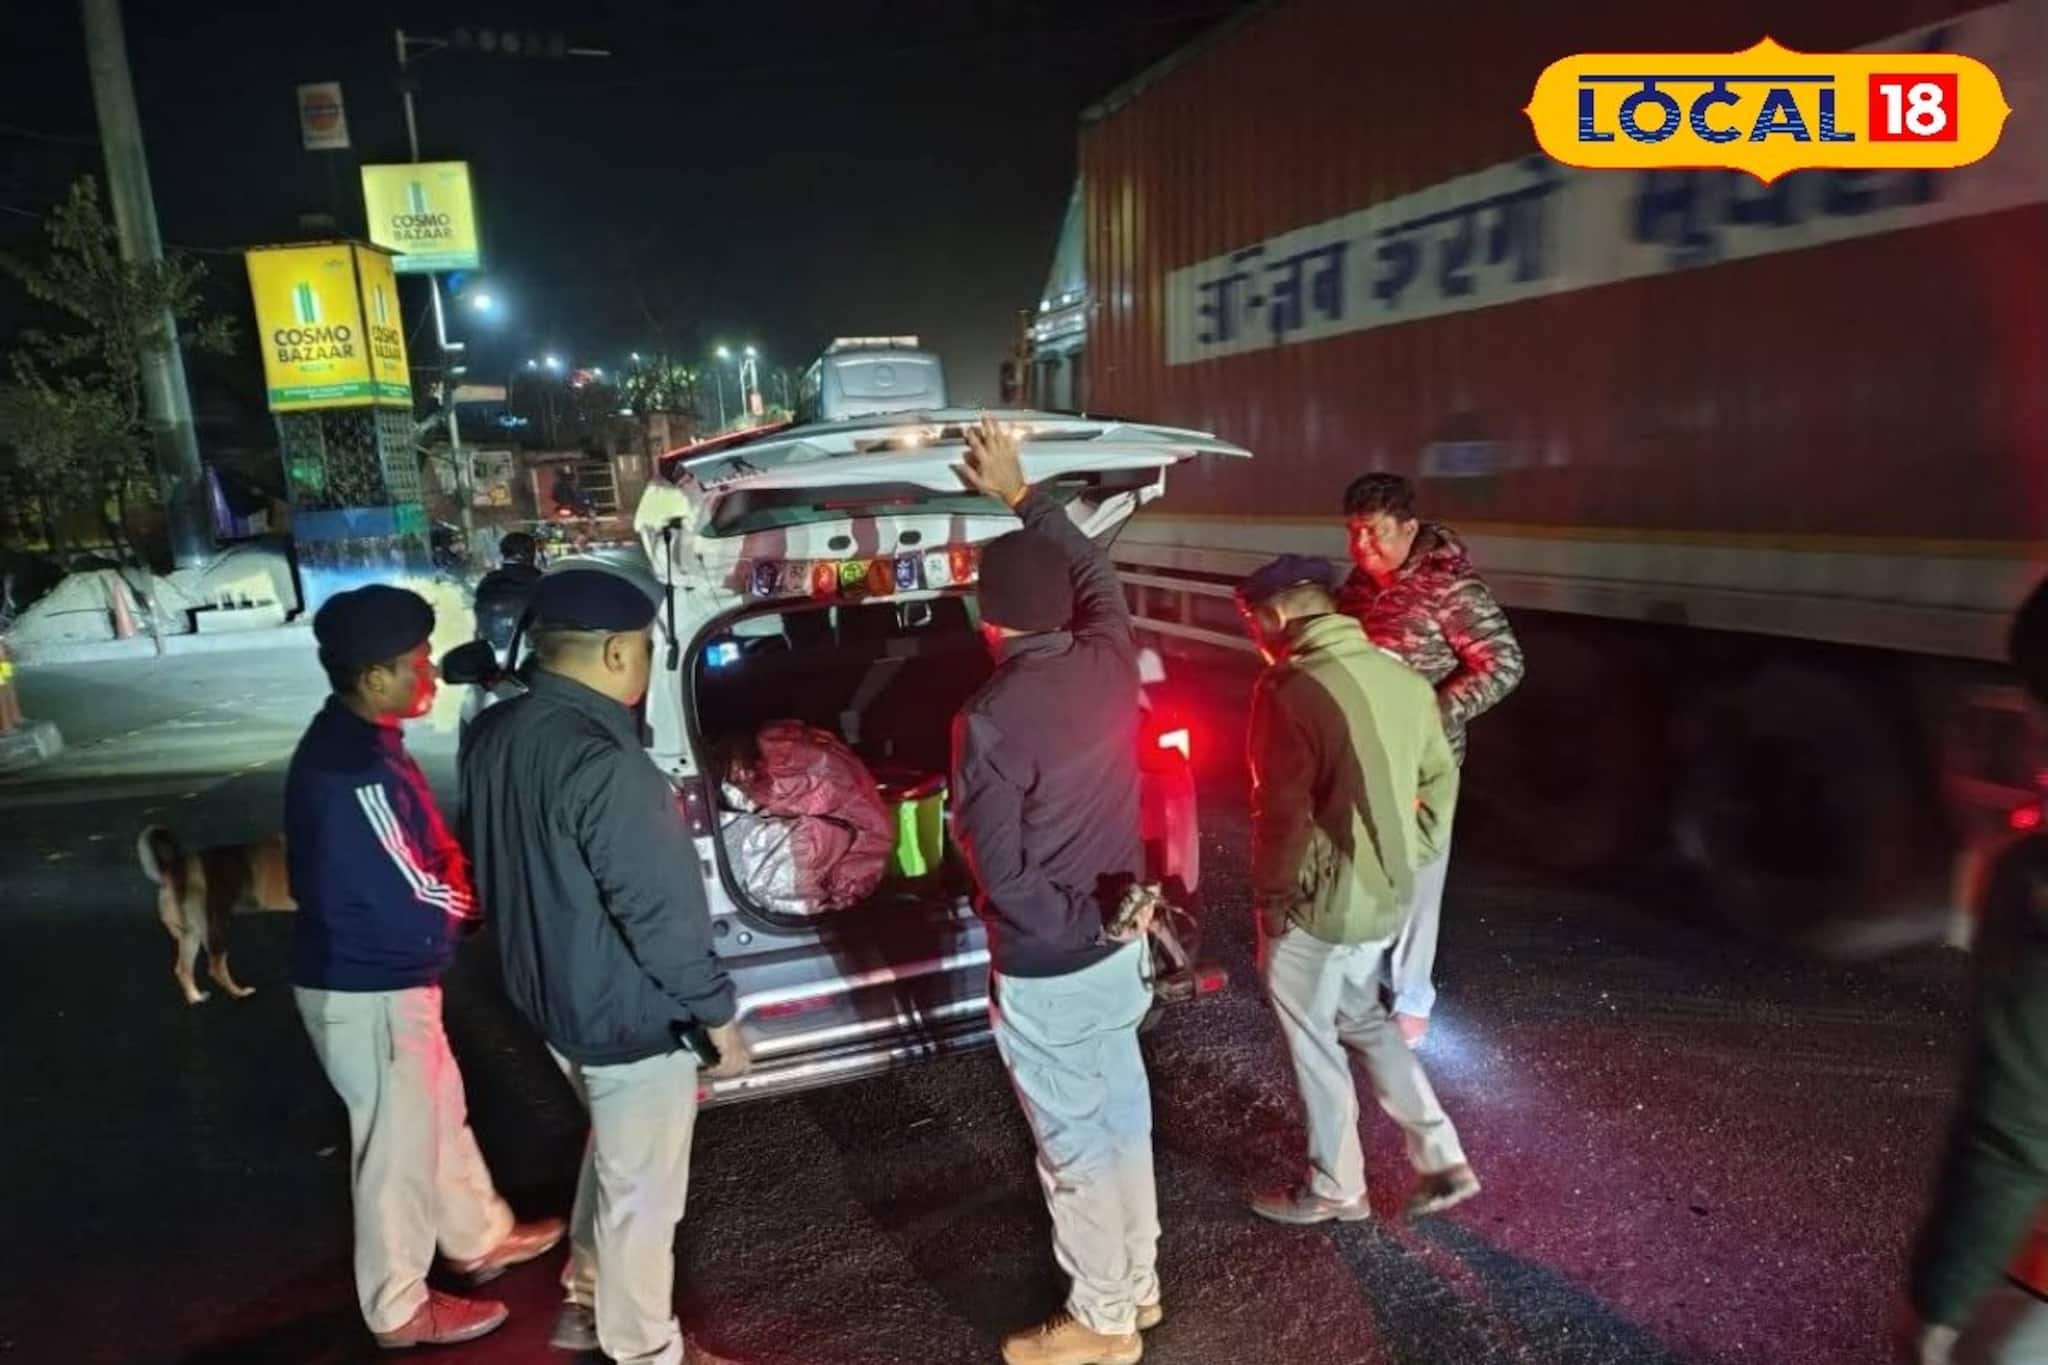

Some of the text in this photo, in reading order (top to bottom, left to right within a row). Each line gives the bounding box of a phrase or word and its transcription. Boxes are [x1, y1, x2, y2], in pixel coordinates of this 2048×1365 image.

[391, 213, 451, 228] COSMO
[274, 325, 351, 346] COSMO
[278, 344, 355, 363] BAZAAR
